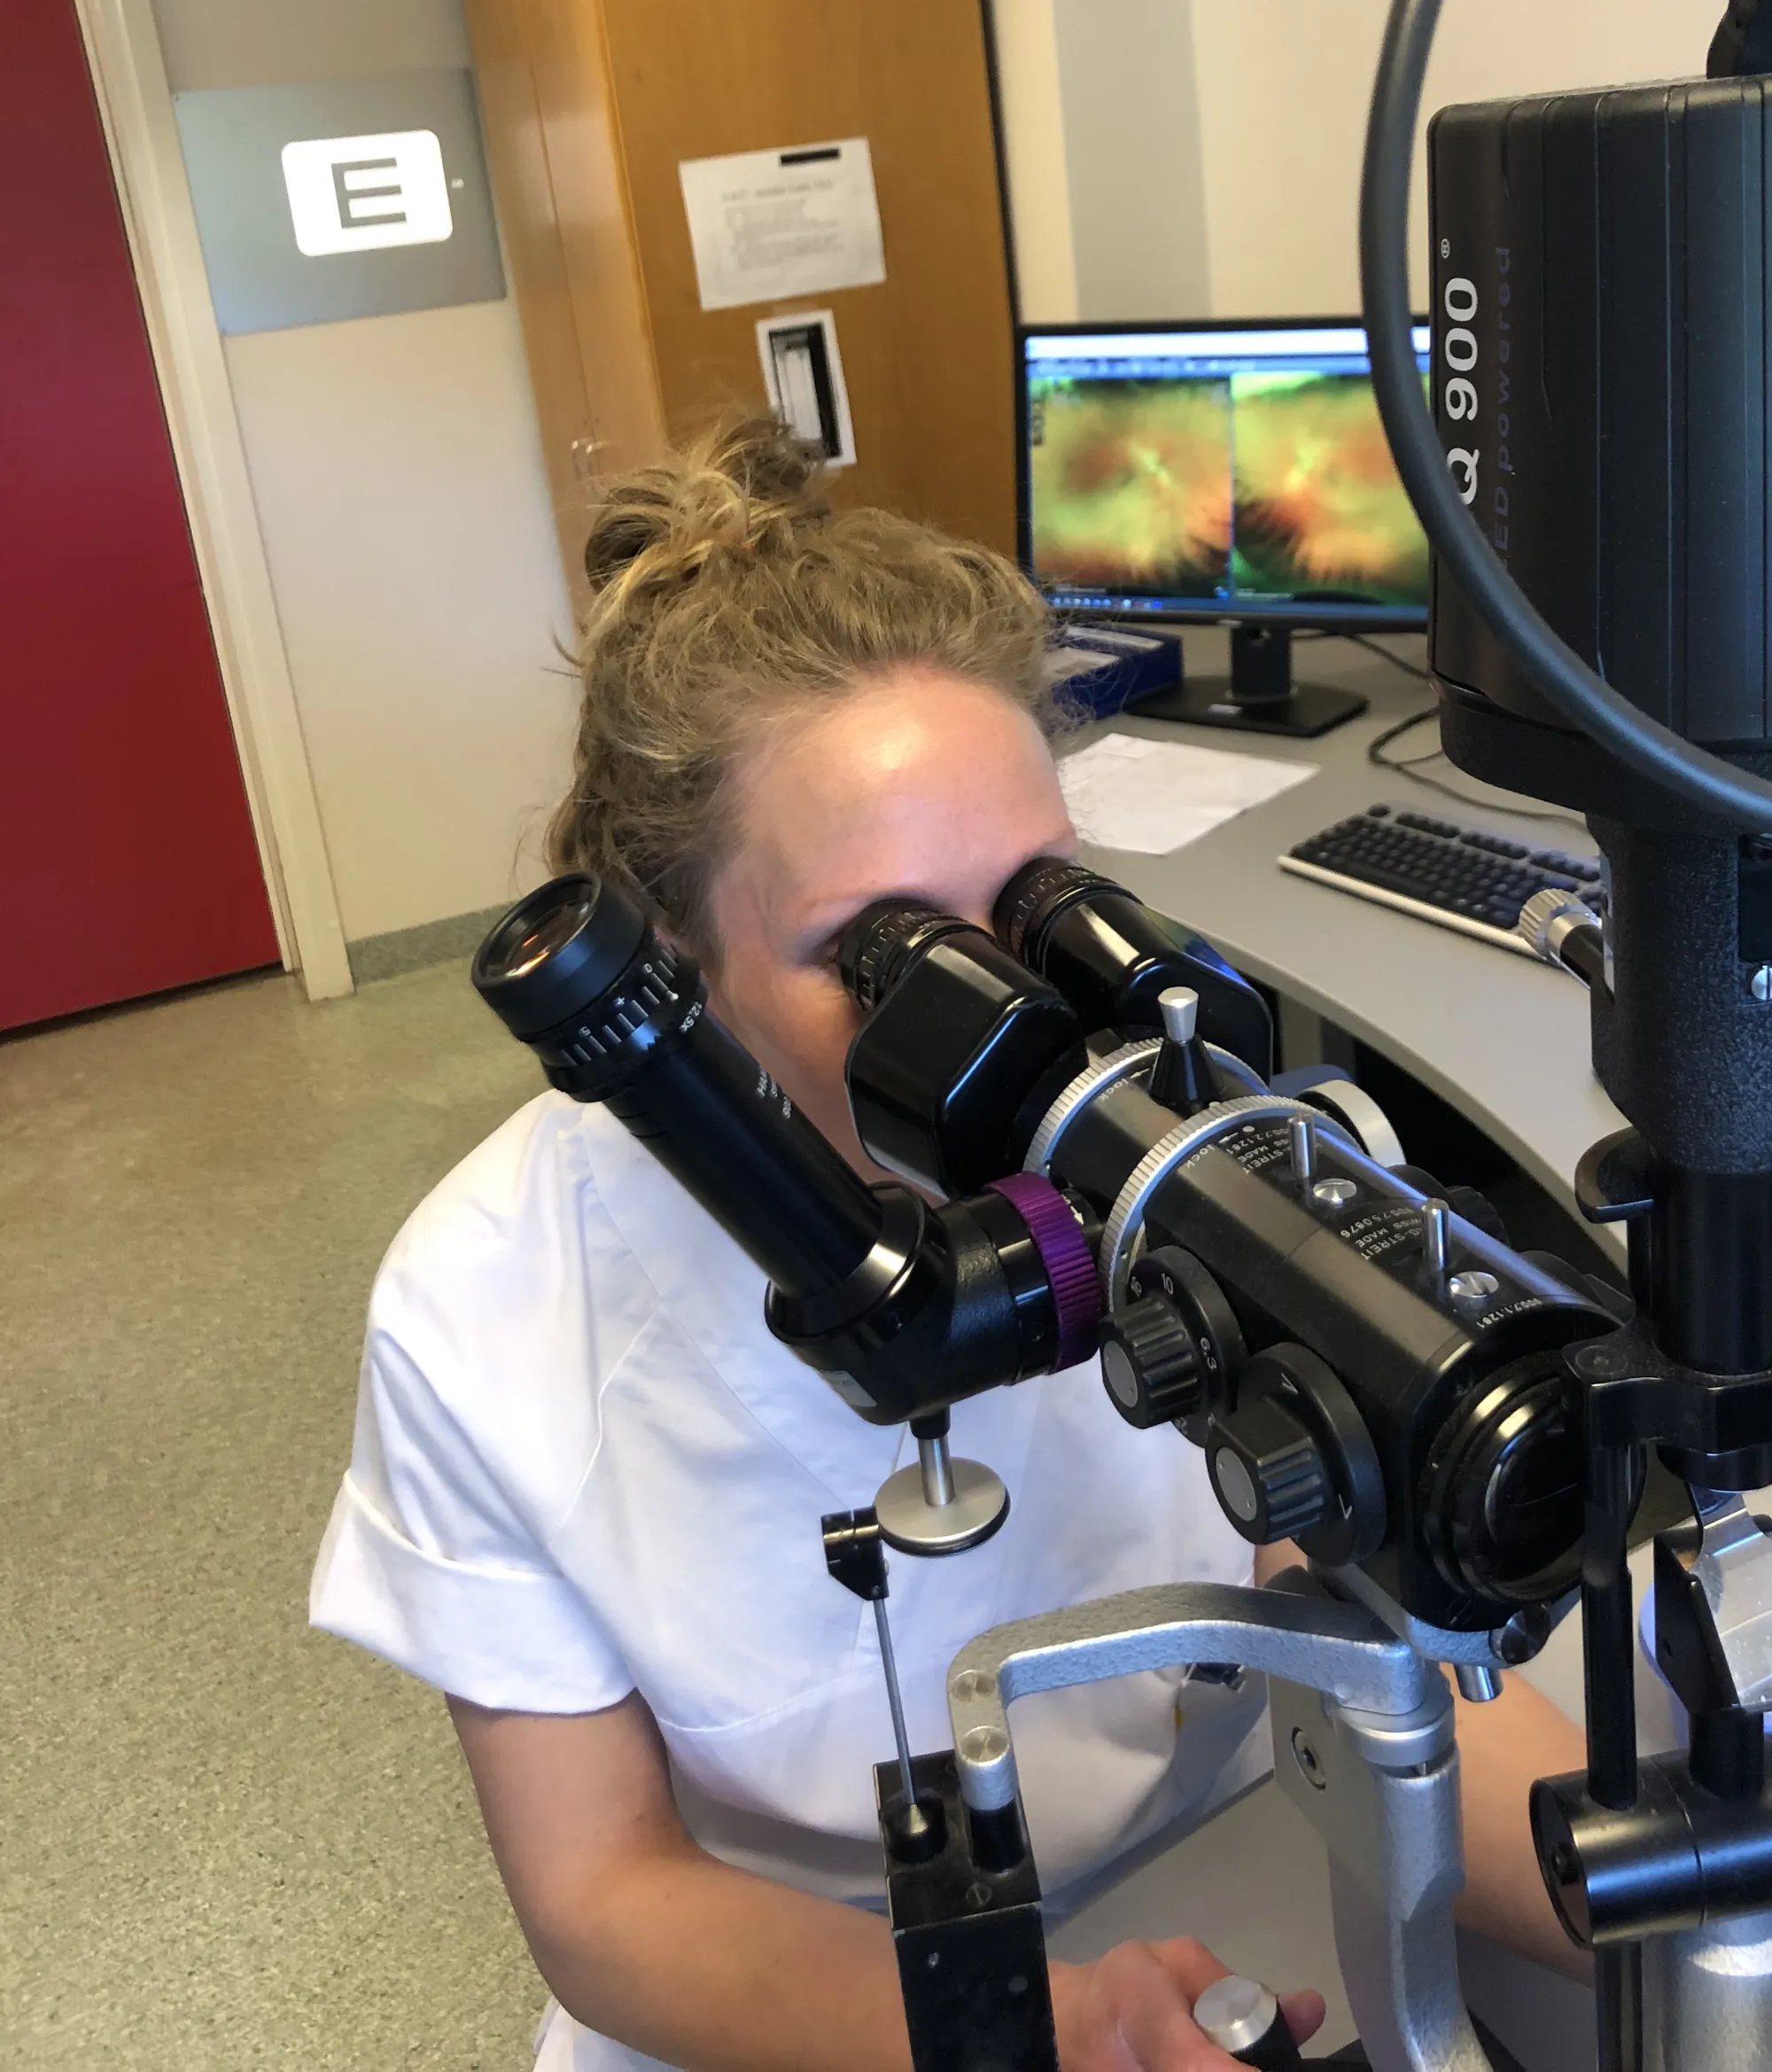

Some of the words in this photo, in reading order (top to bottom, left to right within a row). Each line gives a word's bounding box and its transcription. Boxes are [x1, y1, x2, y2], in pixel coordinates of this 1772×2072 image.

[330, 156, 408, 230] E
[1098, 1078, 1130, 1102] lock
[1185, 1144, 1216, 1169] lock
[1238, 1144, 1269, 1163] MADE
[1355, 1227, 1389, 1248] MADE
[1161, 1273, 1174, 1295] 10
[1200, 1336, 1217, 1370] 6.3
